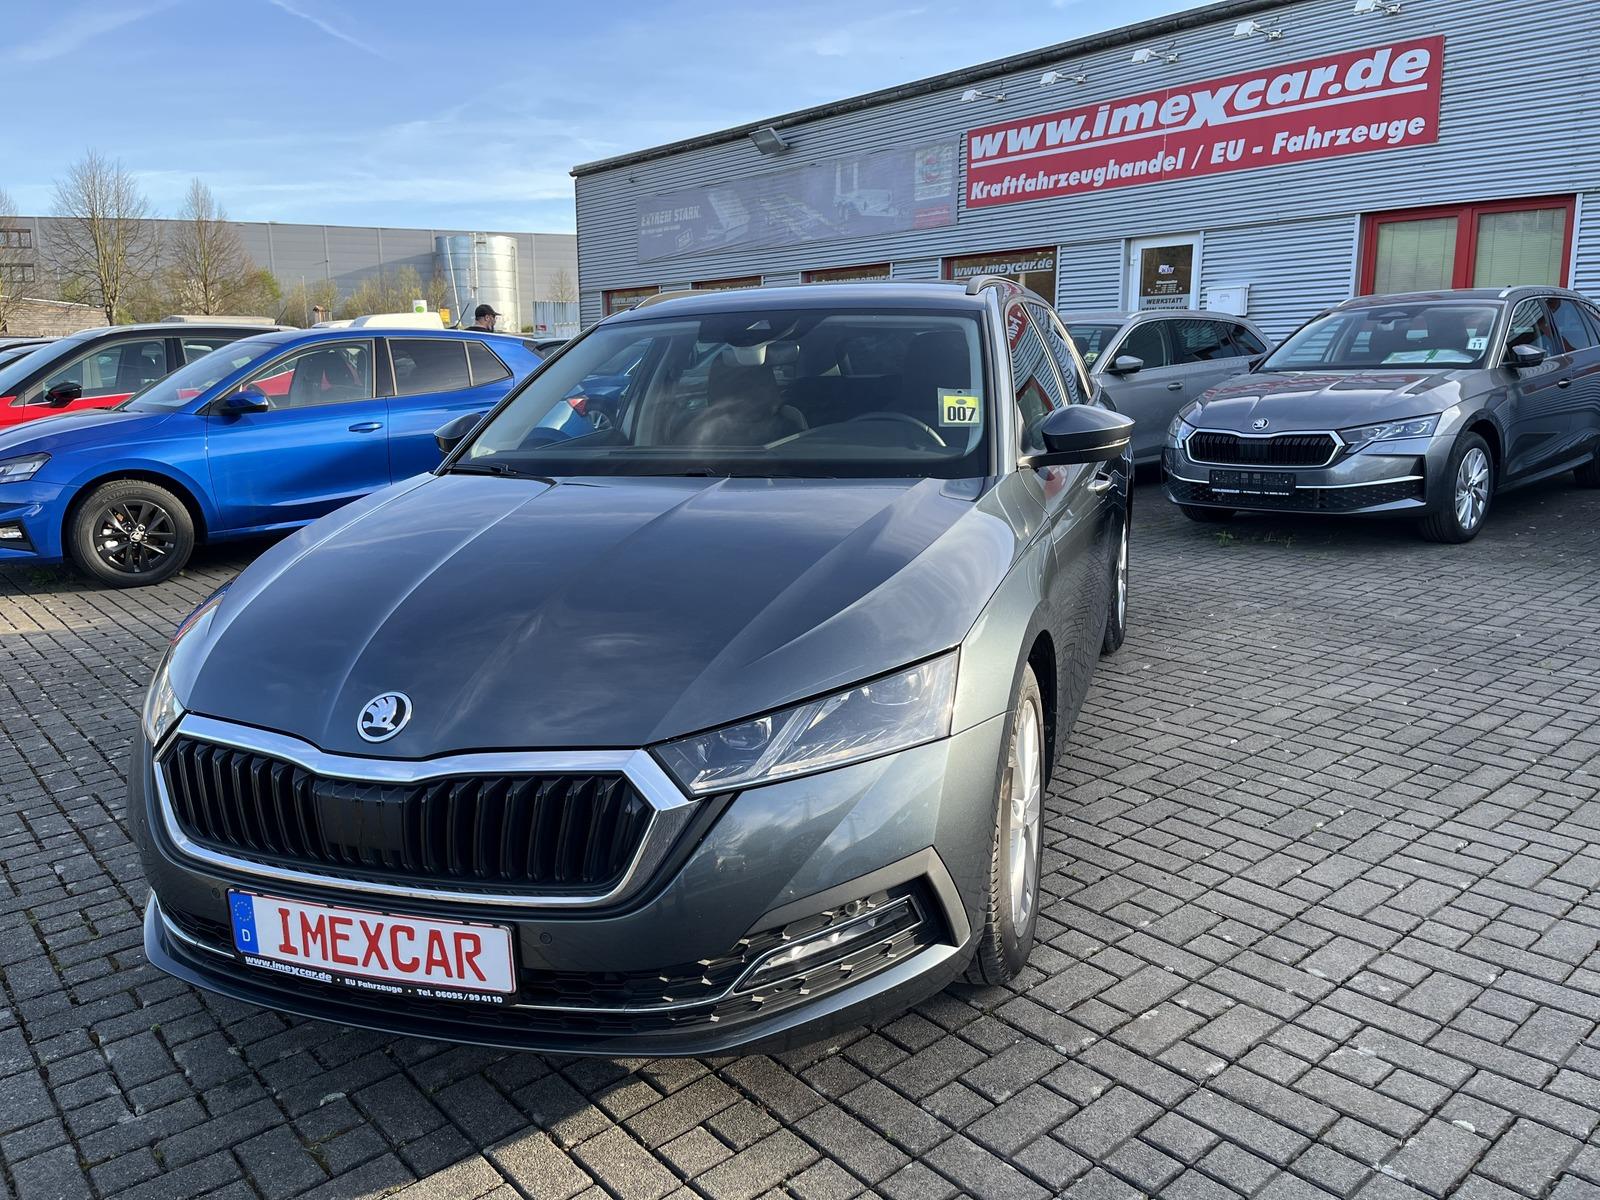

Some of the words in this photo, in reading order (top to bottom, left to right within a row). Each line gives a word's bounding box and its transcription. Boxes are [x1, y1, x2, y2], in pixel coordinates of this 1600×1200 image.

[970, 47, 1430, 160] www.imexcar.de
[970, 147, 1185, 200] Kraftfahrzeughandel
[1210, 138, 1246, 164] EU
[1271, 115, 1426, 155] Fahrzeuge
[1146, 297, 1183, 305] WERKSTATT
[947, 405, 976, 422] 007
[242, 928, 251, 942] D
[277, 907, 486, 982] IMEXCAR
[245, 956, 332, 982] www.imexcar.de
[344, 977, 356, 986] EU
[357, 980, 403, 994] Fahrzeuge
[416, 988, 434, 997] Tel.
